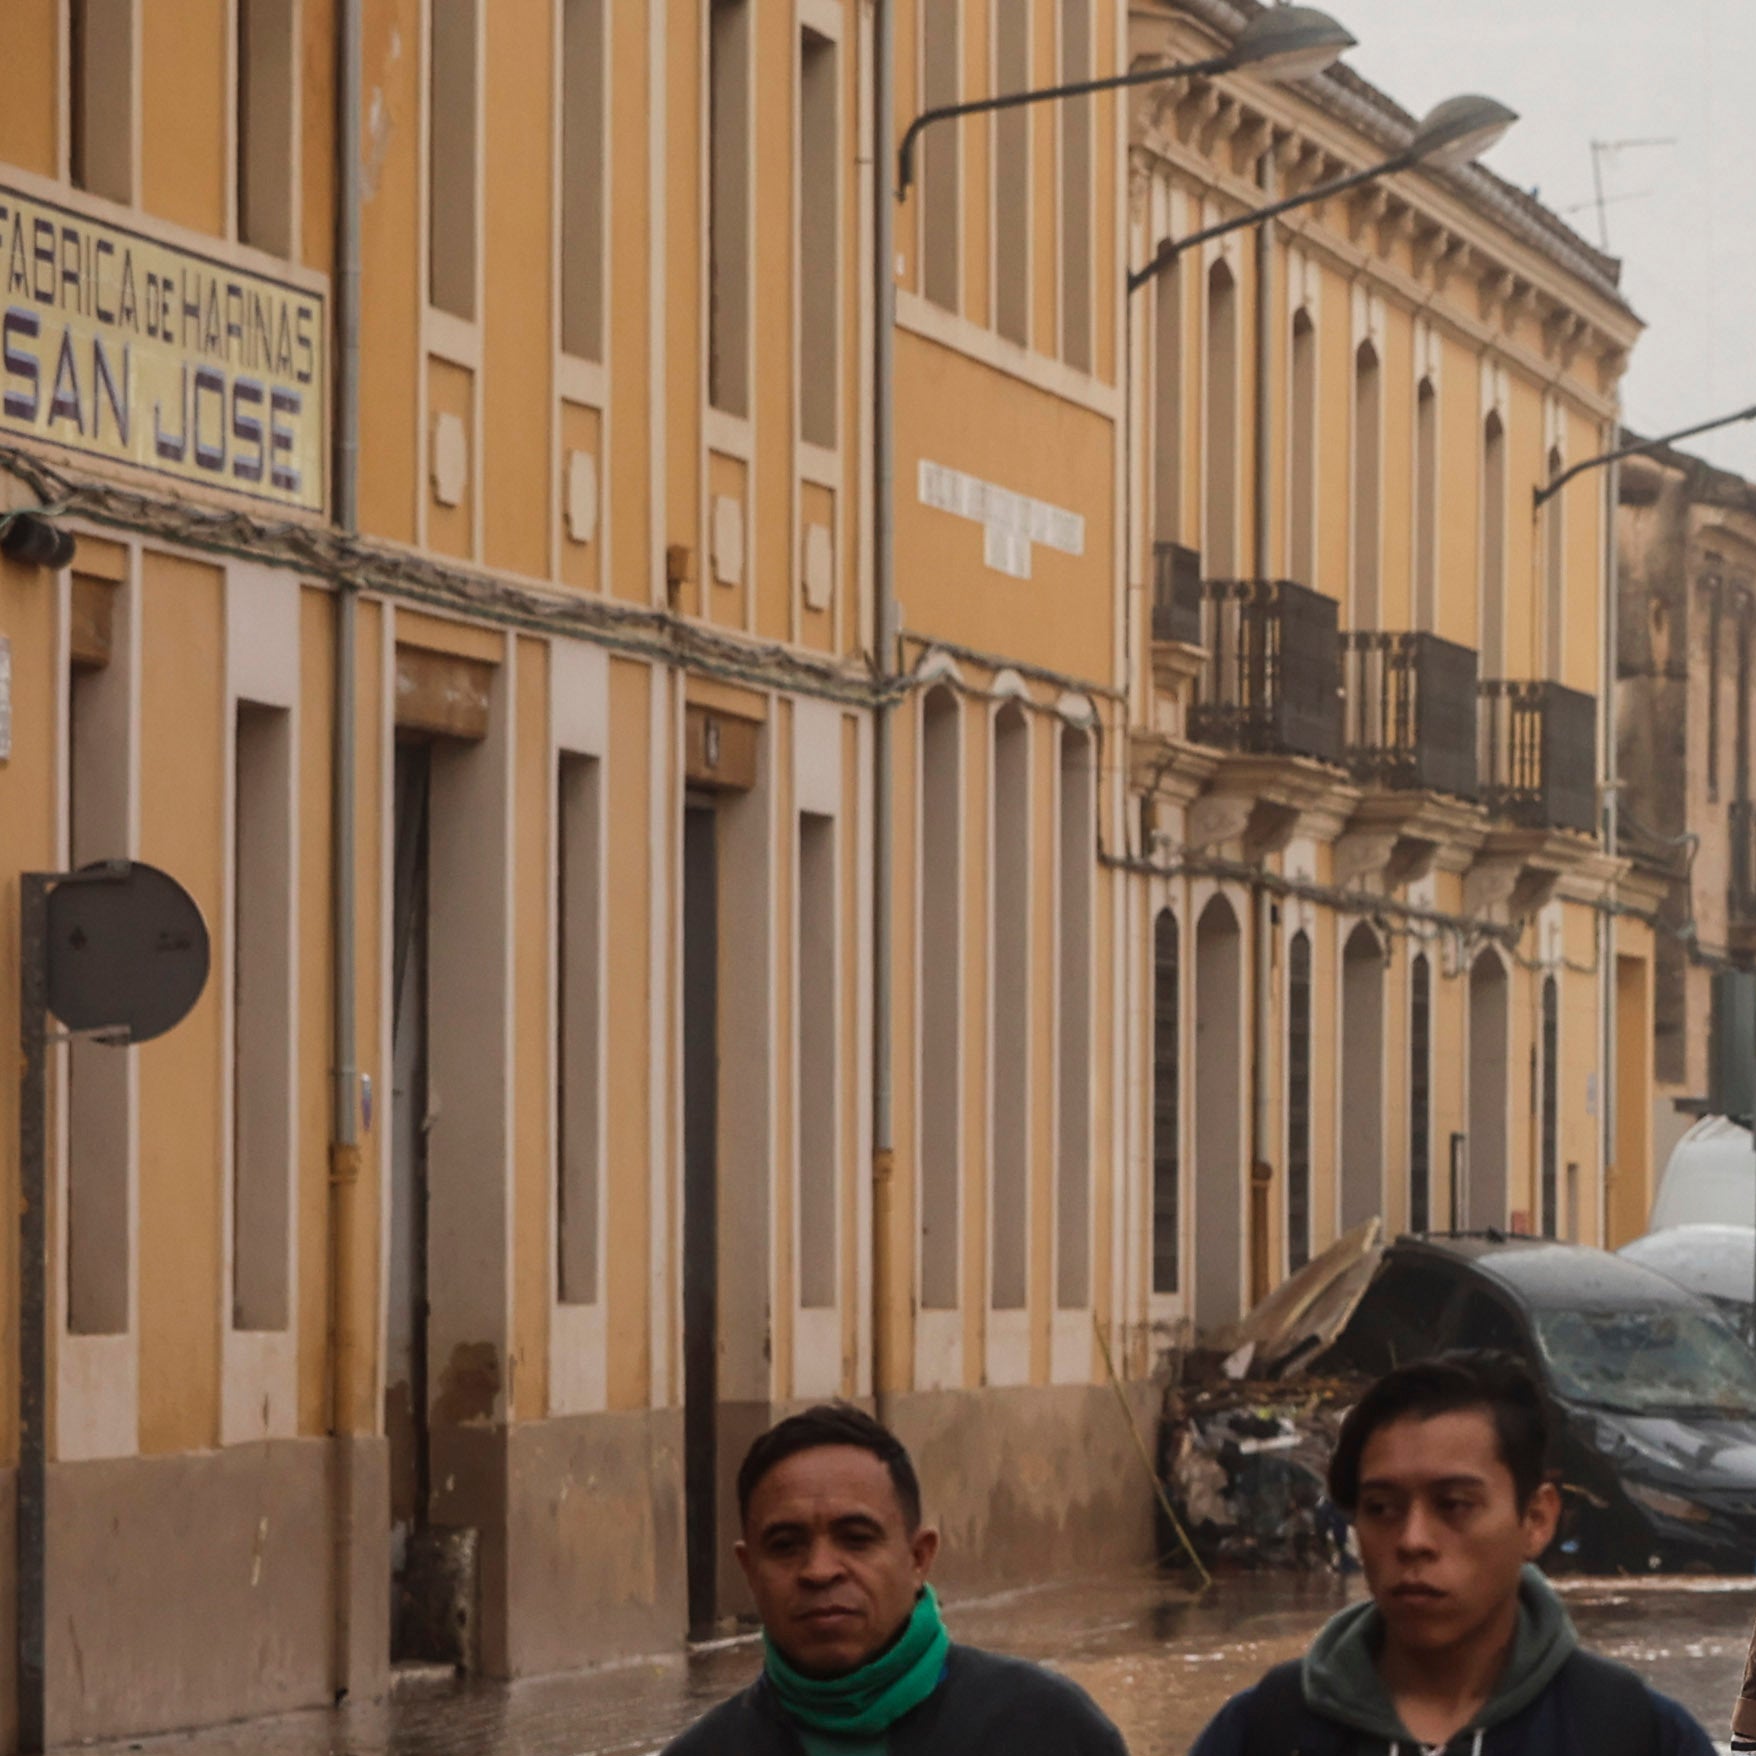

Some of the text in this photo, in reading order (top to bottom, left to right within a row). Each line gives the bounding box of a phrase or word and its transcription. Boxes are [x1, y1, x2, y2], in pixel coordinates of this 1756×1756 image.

[3, 305, 302, 493] SAN JOSE
[147, 272, 174, 344] DE
[182, 267, 313, 384] HARINAS
